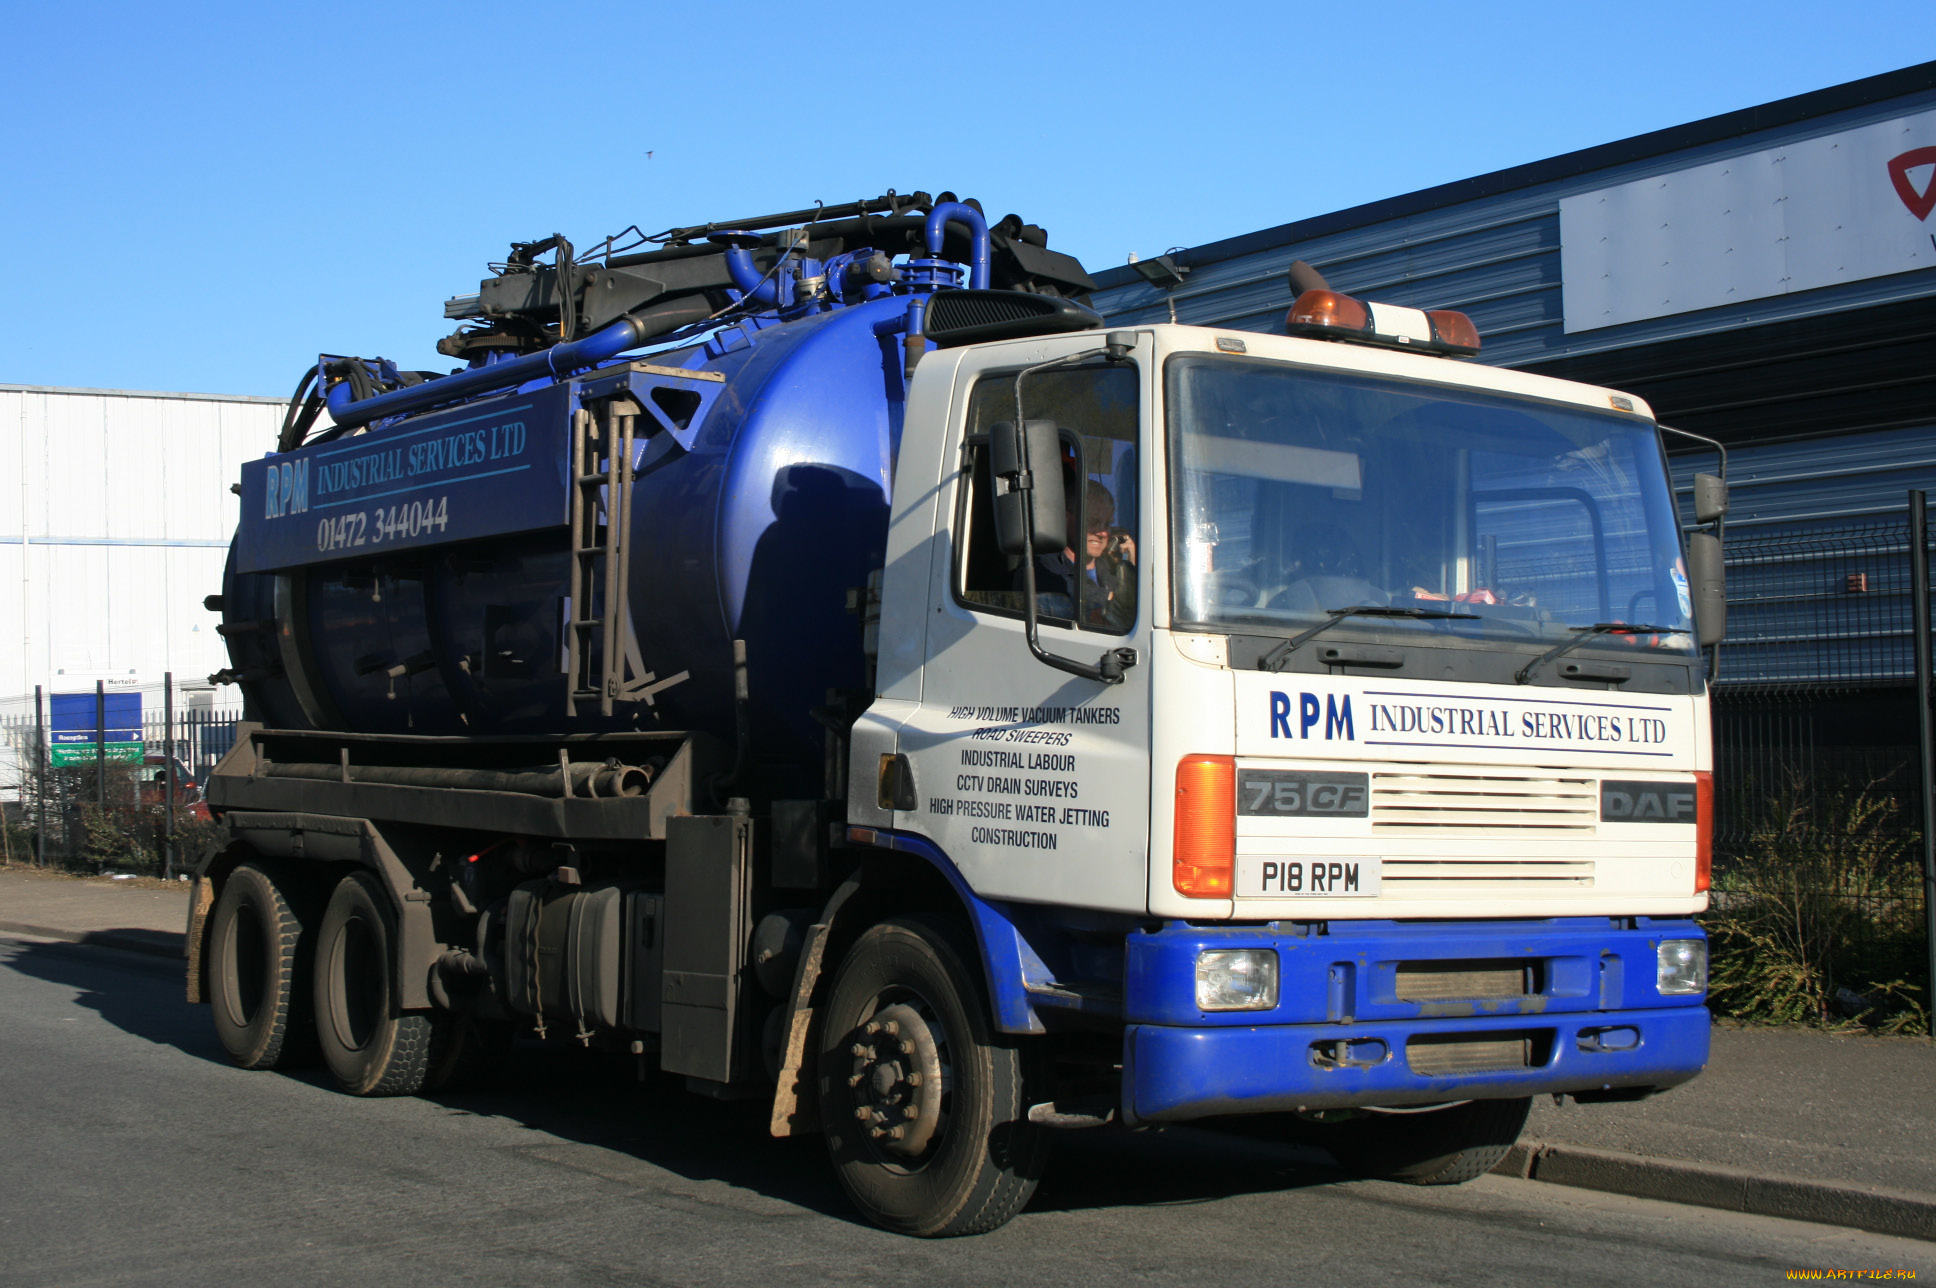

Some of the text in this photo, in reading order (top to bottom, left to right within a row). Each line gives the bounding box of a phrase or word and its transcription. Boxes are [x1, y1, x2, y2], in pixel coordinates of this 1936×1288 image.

[265, 421, 527, 520] RPM INDUSTRIAL SERVICES LTD
[317, 496, 449, 552] 01472 344044
[946, 706, 1121, 725] HIGH VOLUME VACUUM TANKERS
[1269, 690, 1667, 744] RPM INDUSTRIAL SERVICES LTD
[971, 727, 1073, 747] ROAD SWEEPERS
[961, 749, 1076, 772] INDUSTRIAL LABOUR
[956, 774, 1078, 799] CCTV DRAIN SURVEYS
[929, 797, 1110, 828] HIGH PRESSURE WATER JETTING
[1602, 790, 1696, 818] DAF
[971, 826, 1057, 850] CONSTRUCTION
[1262, 862, 1359, 892] P18 RPM
